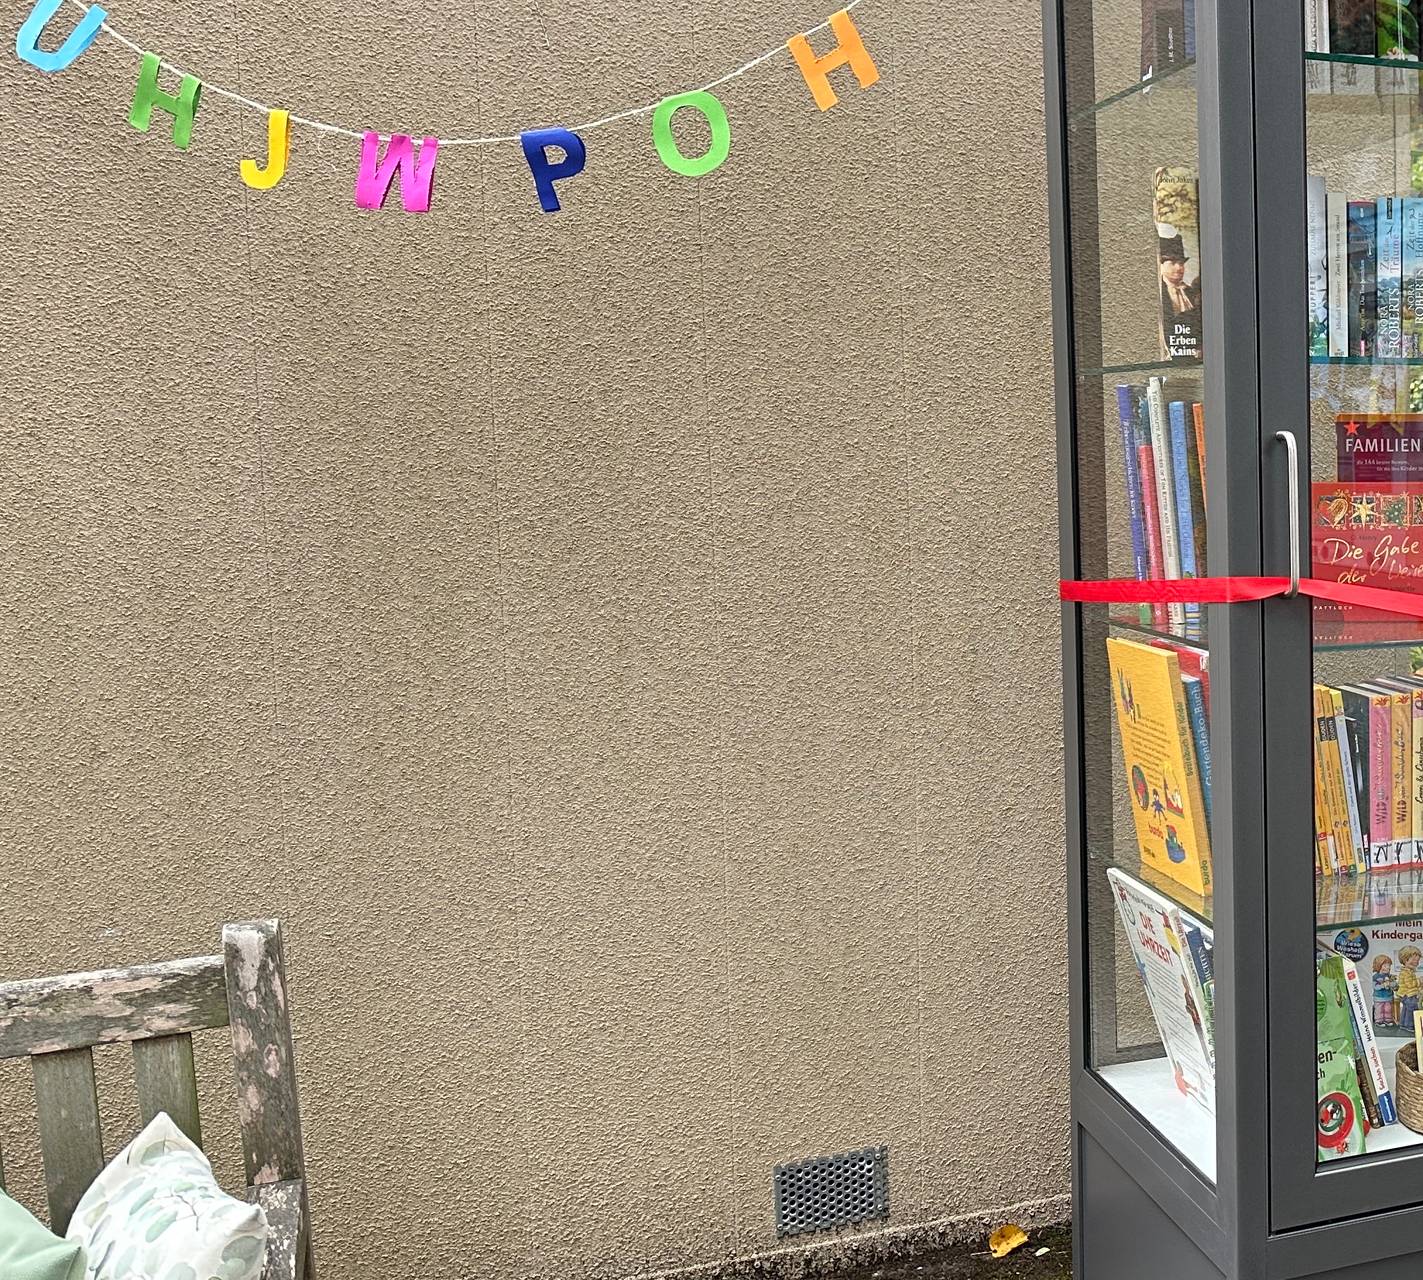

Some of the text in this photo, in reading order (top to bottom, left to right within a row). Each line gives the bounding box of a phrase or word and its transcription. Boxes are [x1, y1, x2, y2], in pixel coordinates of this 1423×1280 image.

[16, 0, 881, 213] U H J W P O H
[1407, 284, 1415, 311] NORA
[1174, 324, 1191, 335] Die
[1380, 306, 1388, 334] NORA
[1389, 287, 1401, 348] ROBERTS
[1169, 335, 1196, 345] Erben
[1170, 346, 1197, 357] Kains
[1324, 535, 1420, 577] Die Gabe
[1338, 564, 1367, 583] der
[1201, 859, 1210, 886] burda
